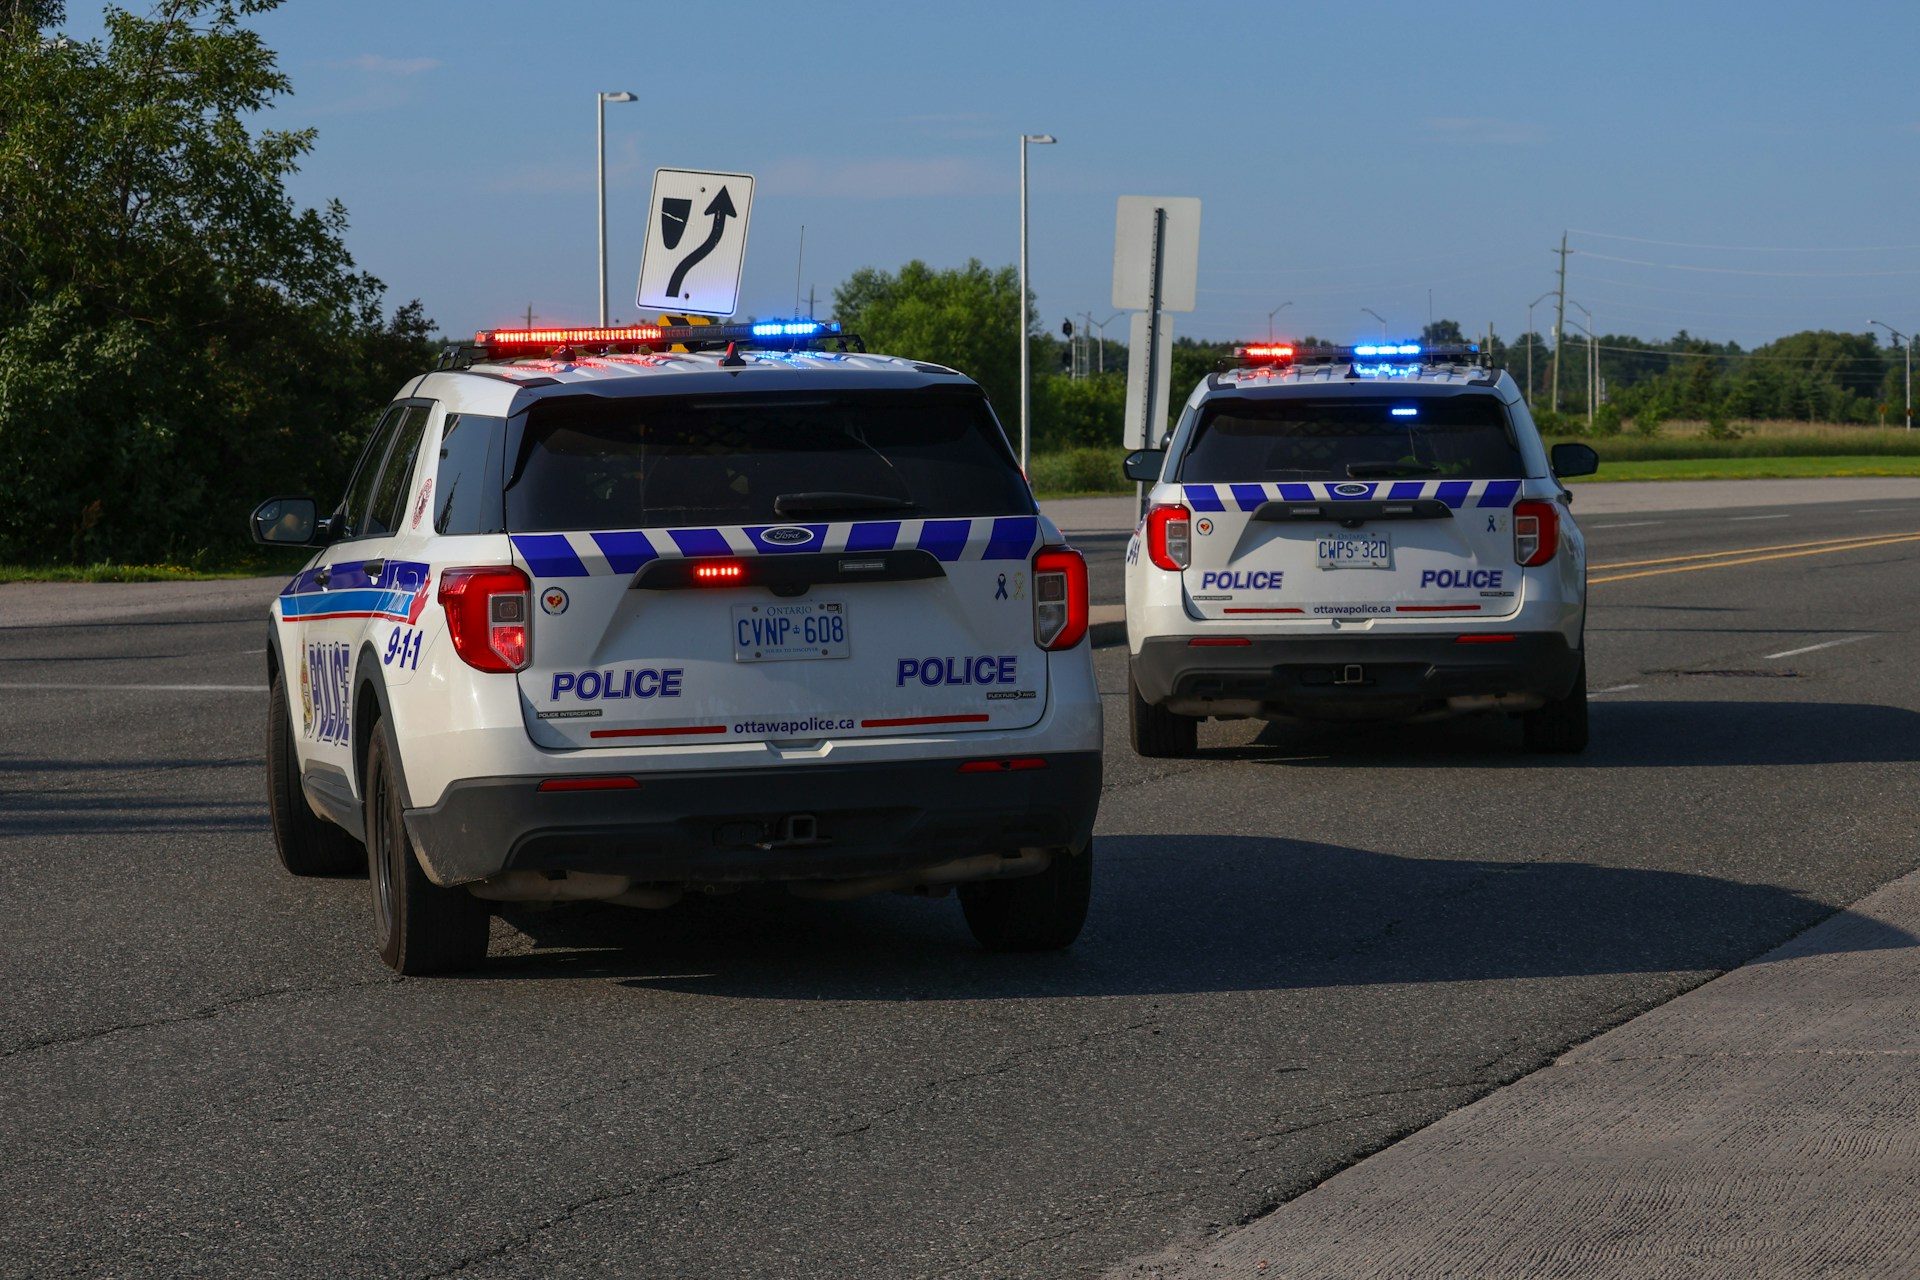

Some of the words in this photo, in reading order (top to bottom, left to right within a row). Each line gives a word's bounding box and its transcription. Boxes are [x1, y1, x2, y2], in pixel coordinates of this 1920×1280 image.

[774, 530, 801, 540] Ford
[1319, 541, 1354, 559] CWPS
[1362, 540, 1387, 558] 320
[1201, 571, 1284, 590] POLICE
[1420, 569, 1503, 588] POLICE
[766, 606, 812, 616] ONTARIO
[1313, 604, 1392, 615] ottawapolice.ca
[737, 617, 790, 646] CVNP
[804, 616, 844, 644] 608
[383, 626, 423, 670] 9-1-1
[896, 655, 1018, 687] POLICE
[550, 667, 684, 701] POLICE
[308, 641, 350, 747] POLICE
[734, 717, 855, 735] ottawapolice.ca
